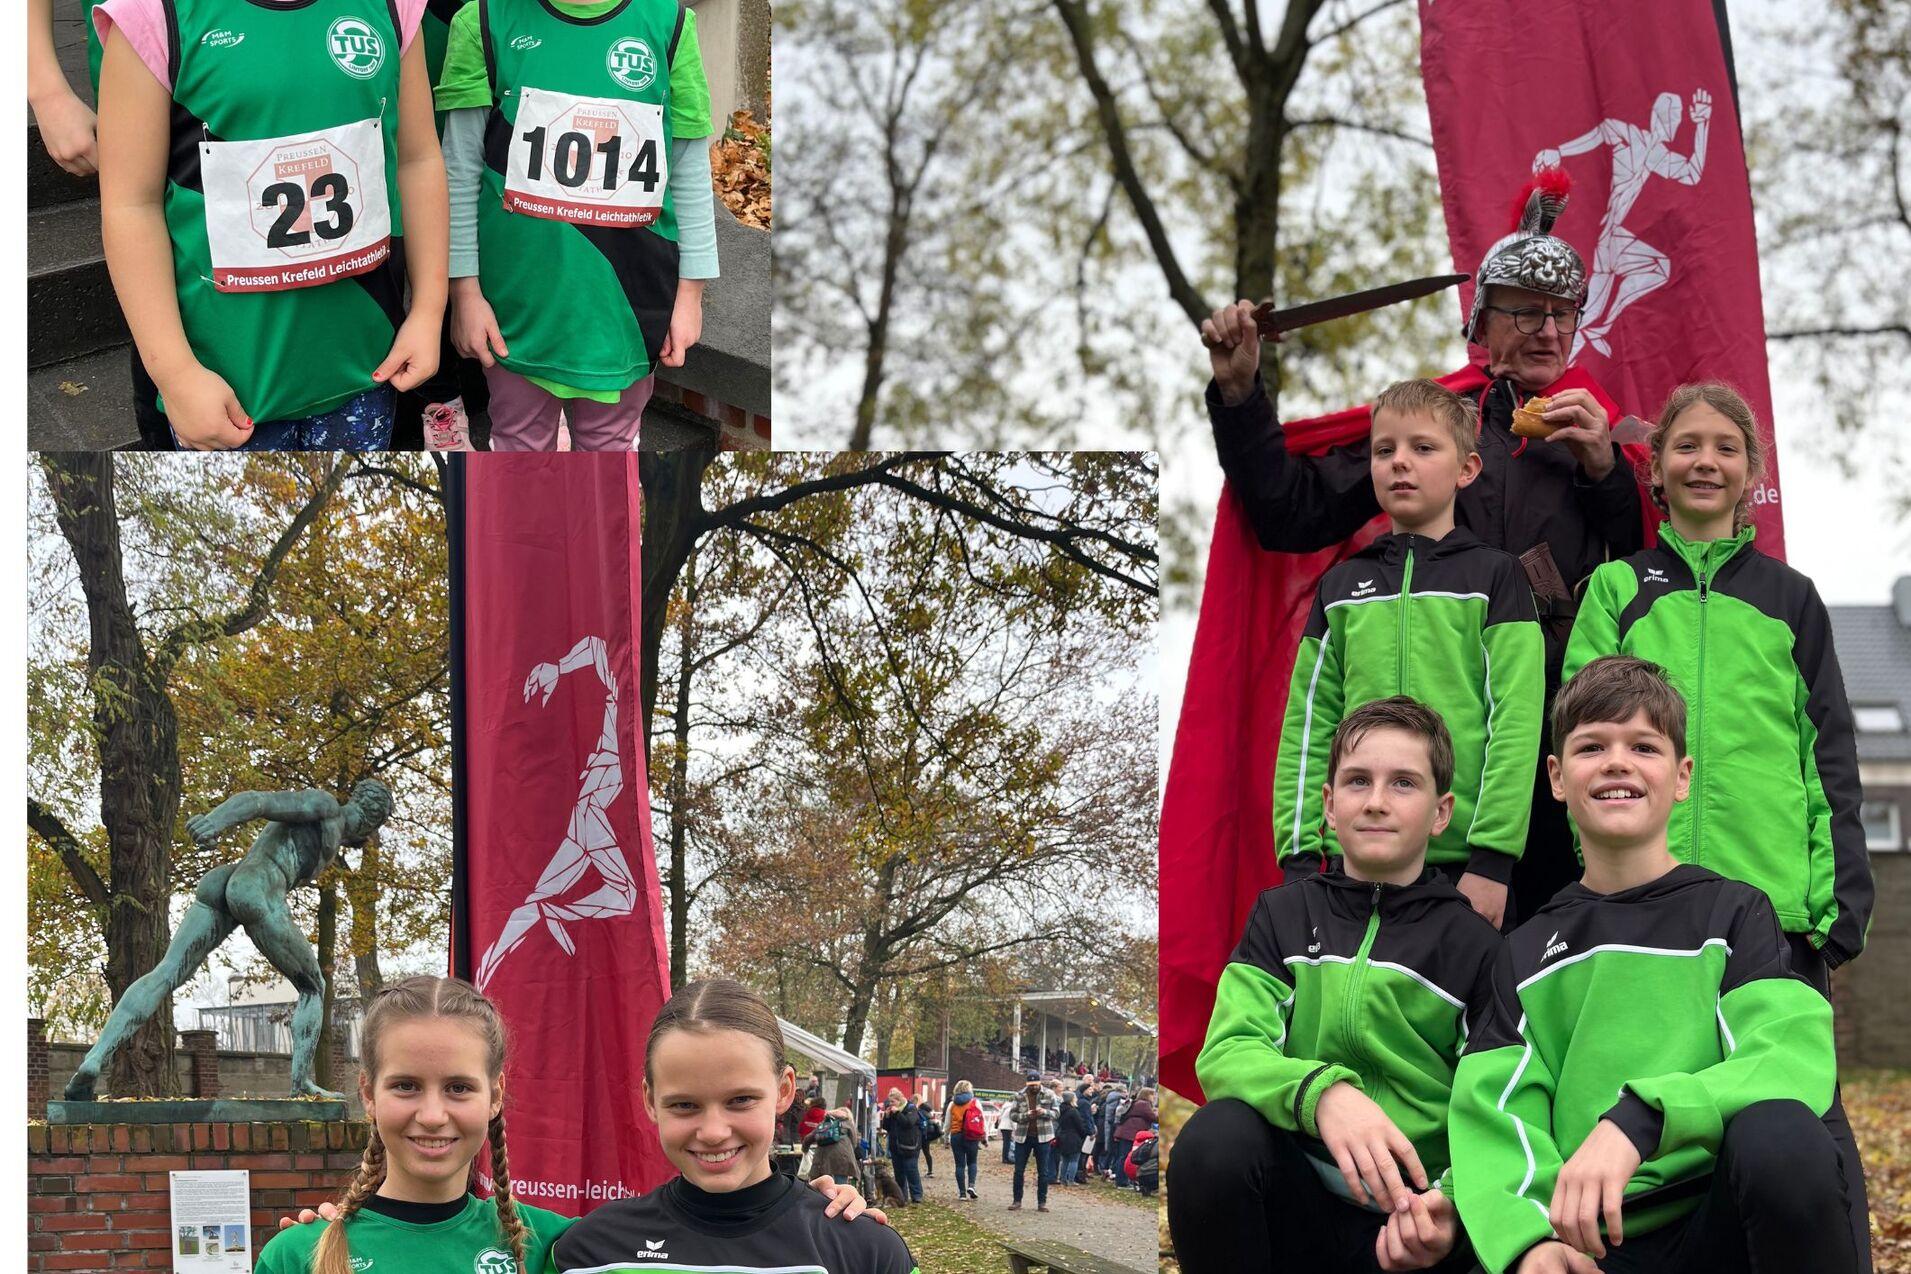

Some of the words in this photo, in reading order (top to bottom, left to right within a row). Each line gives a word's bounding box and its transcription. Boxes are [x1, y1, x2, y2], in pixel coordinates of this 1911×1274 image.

[210, 37, 237, 47] SPORTS
[333, 35, 378, 56] TUS
[614, 53, 654, 73] TUS
[278, 156, 329, 175] KREFELD
[522, 126, 660, 193] 1014
[261, 172, 354, 249] 23
[514, 197, 554, 215] Preussen
[556, 205, 593, 221] Krefeld
[595, 210, 653, 223] Leichtathletik
[227, 274, 279, 286] Preussen
[281, 265, 326, 284] Krefeld
[1643, 574, 1669, 583] erima
[1540, 941, 1569, 963] rima
[637, 1250, 669, 1259] erima
